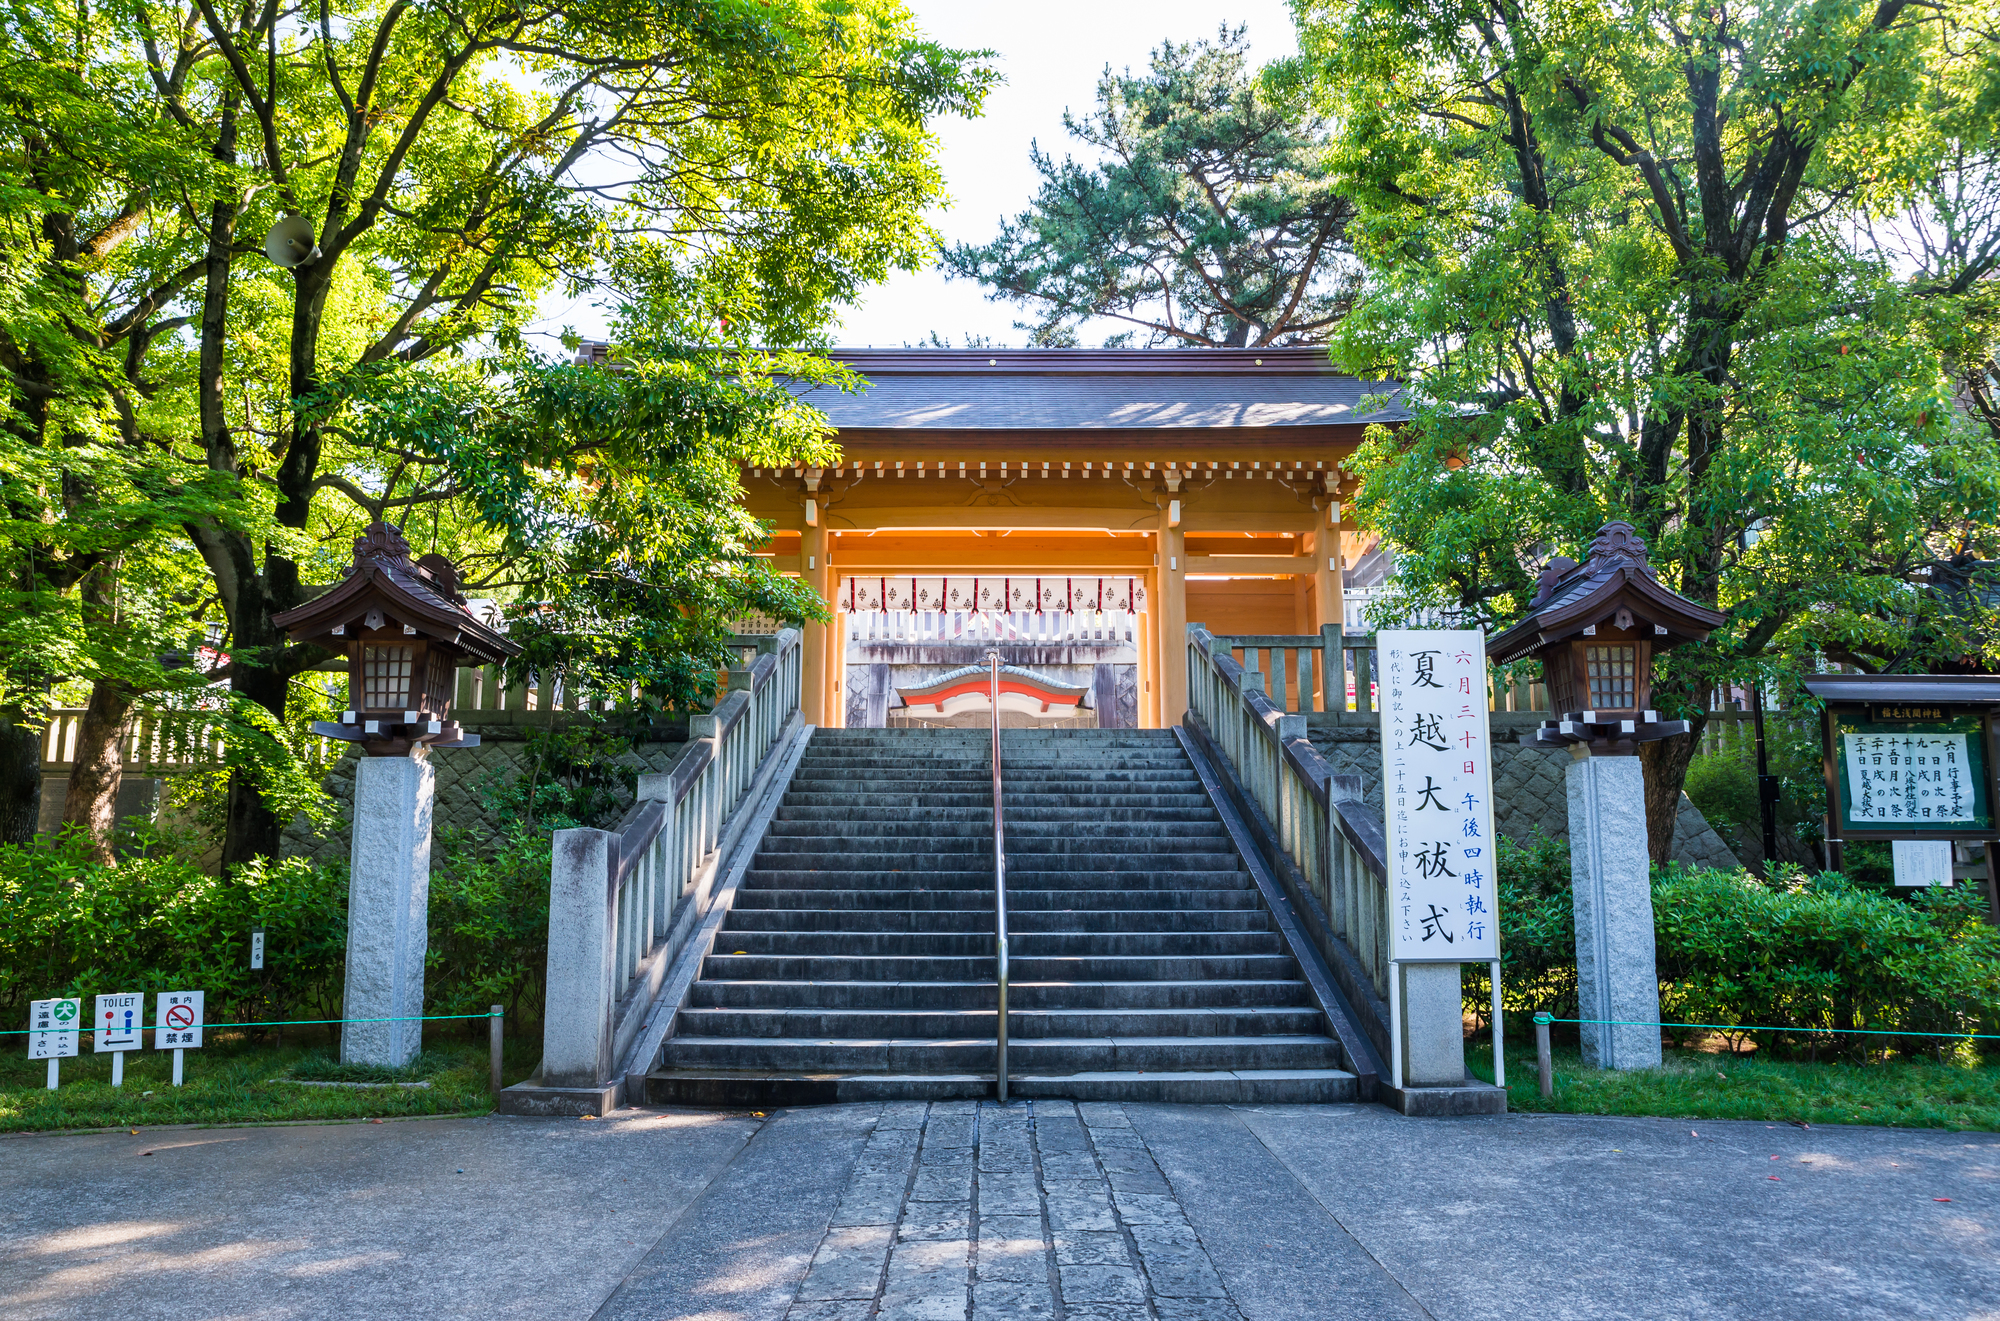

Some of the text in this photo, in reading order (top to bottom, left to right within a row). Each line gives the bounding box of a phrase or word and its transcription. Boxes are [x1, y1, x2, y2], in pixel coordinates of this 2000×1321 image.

[1408, 650, 1458, 944] 夏越大祓式
[103, 997, 135, 1008] TOILET
[169, 996, 192, 1005] 境内
[165, 1032, 194, 1044] 禁煙
